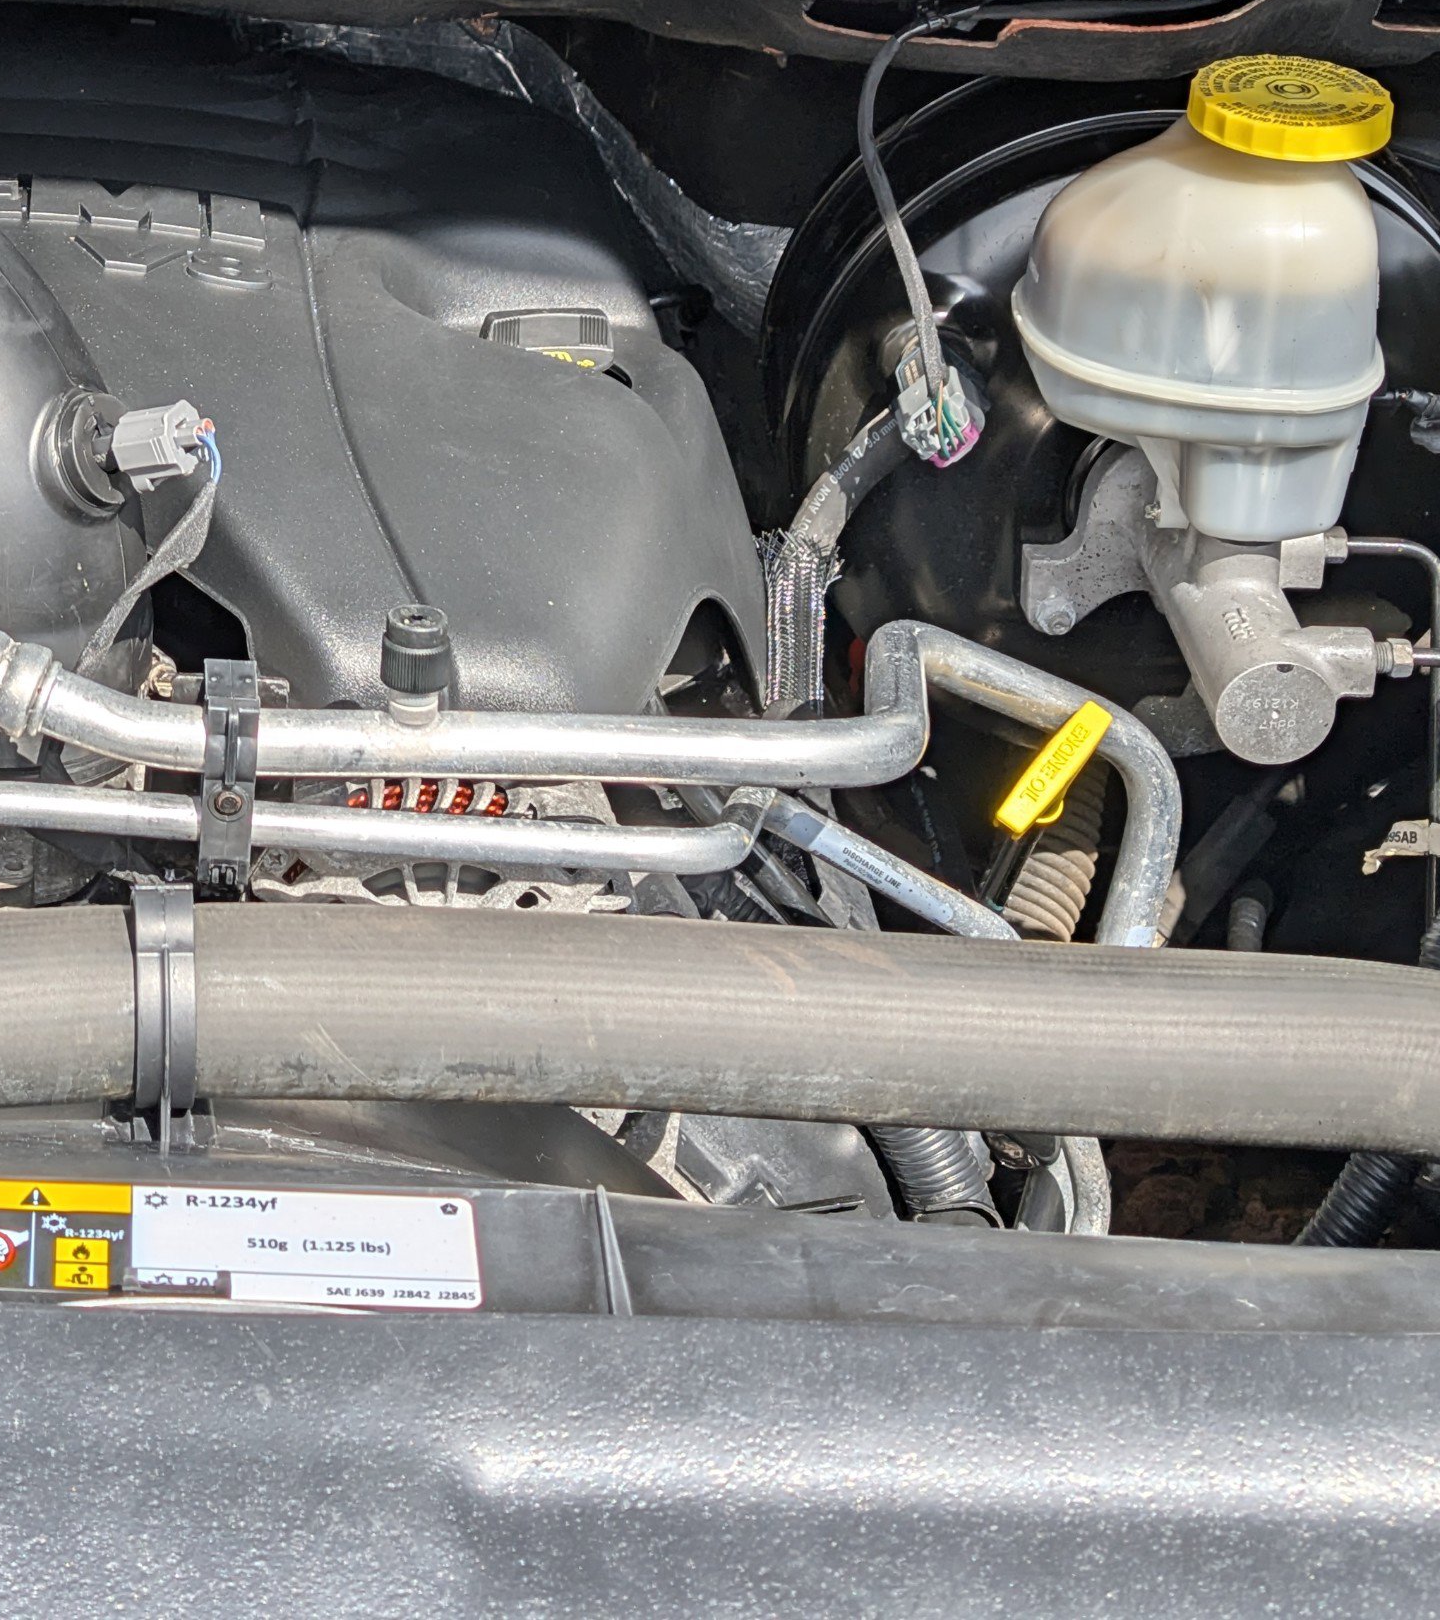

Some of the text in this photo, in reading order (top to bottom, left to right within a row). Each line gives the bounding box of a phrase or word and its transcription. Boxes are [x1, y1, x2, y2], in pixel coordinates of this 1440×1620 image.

[810, 483, 832, 514] AVON
[1252, 698, 1299, 709] K1219
[1019, 723, 1089, 803] ENGINE OIL
[843, 847, 885, 878] DISCHARGE
[884, 874, 902, 890] LINE
[185, 1194, 278, 1212] R-1234yf
[65, 1228, 125, 1241] R-1234yf
[247, 1237, 392, 1256] 510g (1.125 lbs)
[326, 1286, 476, 1301] SAE J639 J2842 J2845
